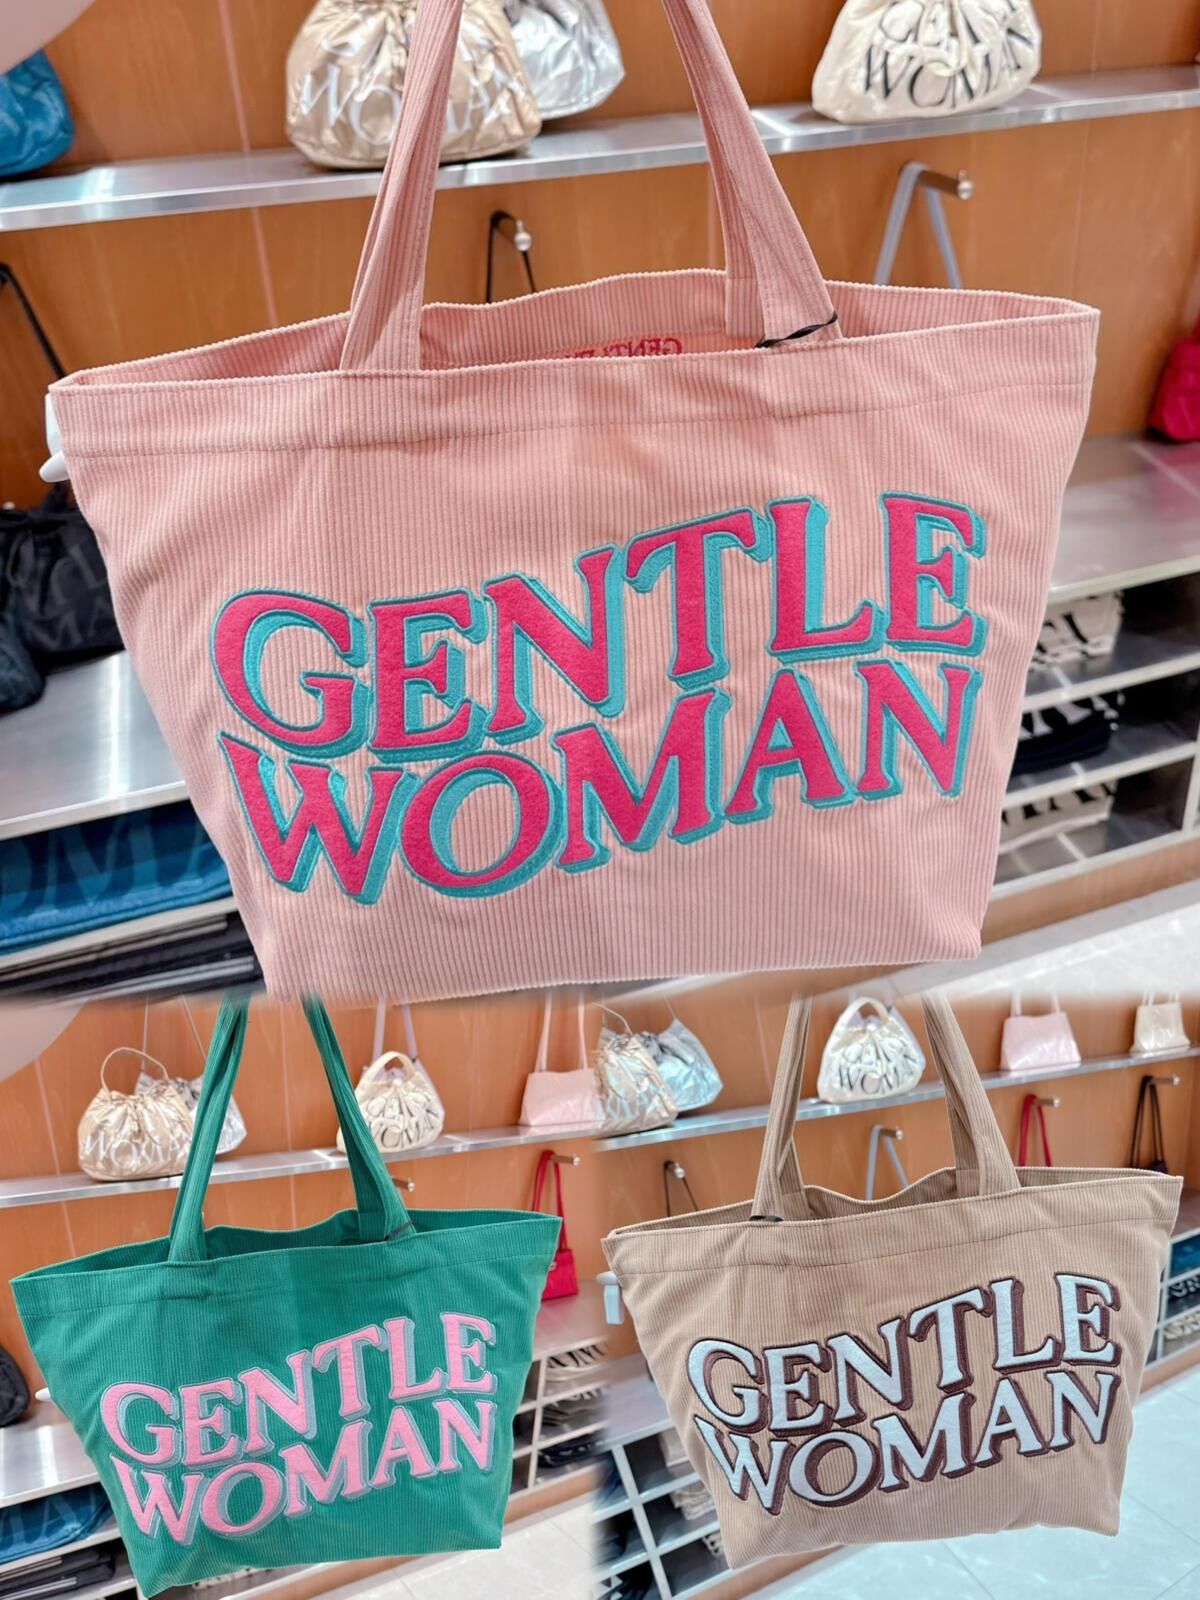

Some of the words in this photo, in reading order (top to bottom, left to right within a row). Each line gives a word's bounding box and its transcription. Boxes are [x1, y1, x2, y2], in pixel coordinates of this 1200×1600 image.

[211, 492, 986, 763] GENTLE
[217, 656, 983, 905] WOMAN
[101, 1312, 497, 1470] GENTLE
[685, 1271, 1121, 1433] GENTLE
[109, 1399, 499, 1547] WOMAN
[693, 1370, 1121, 1515] WOMAN
